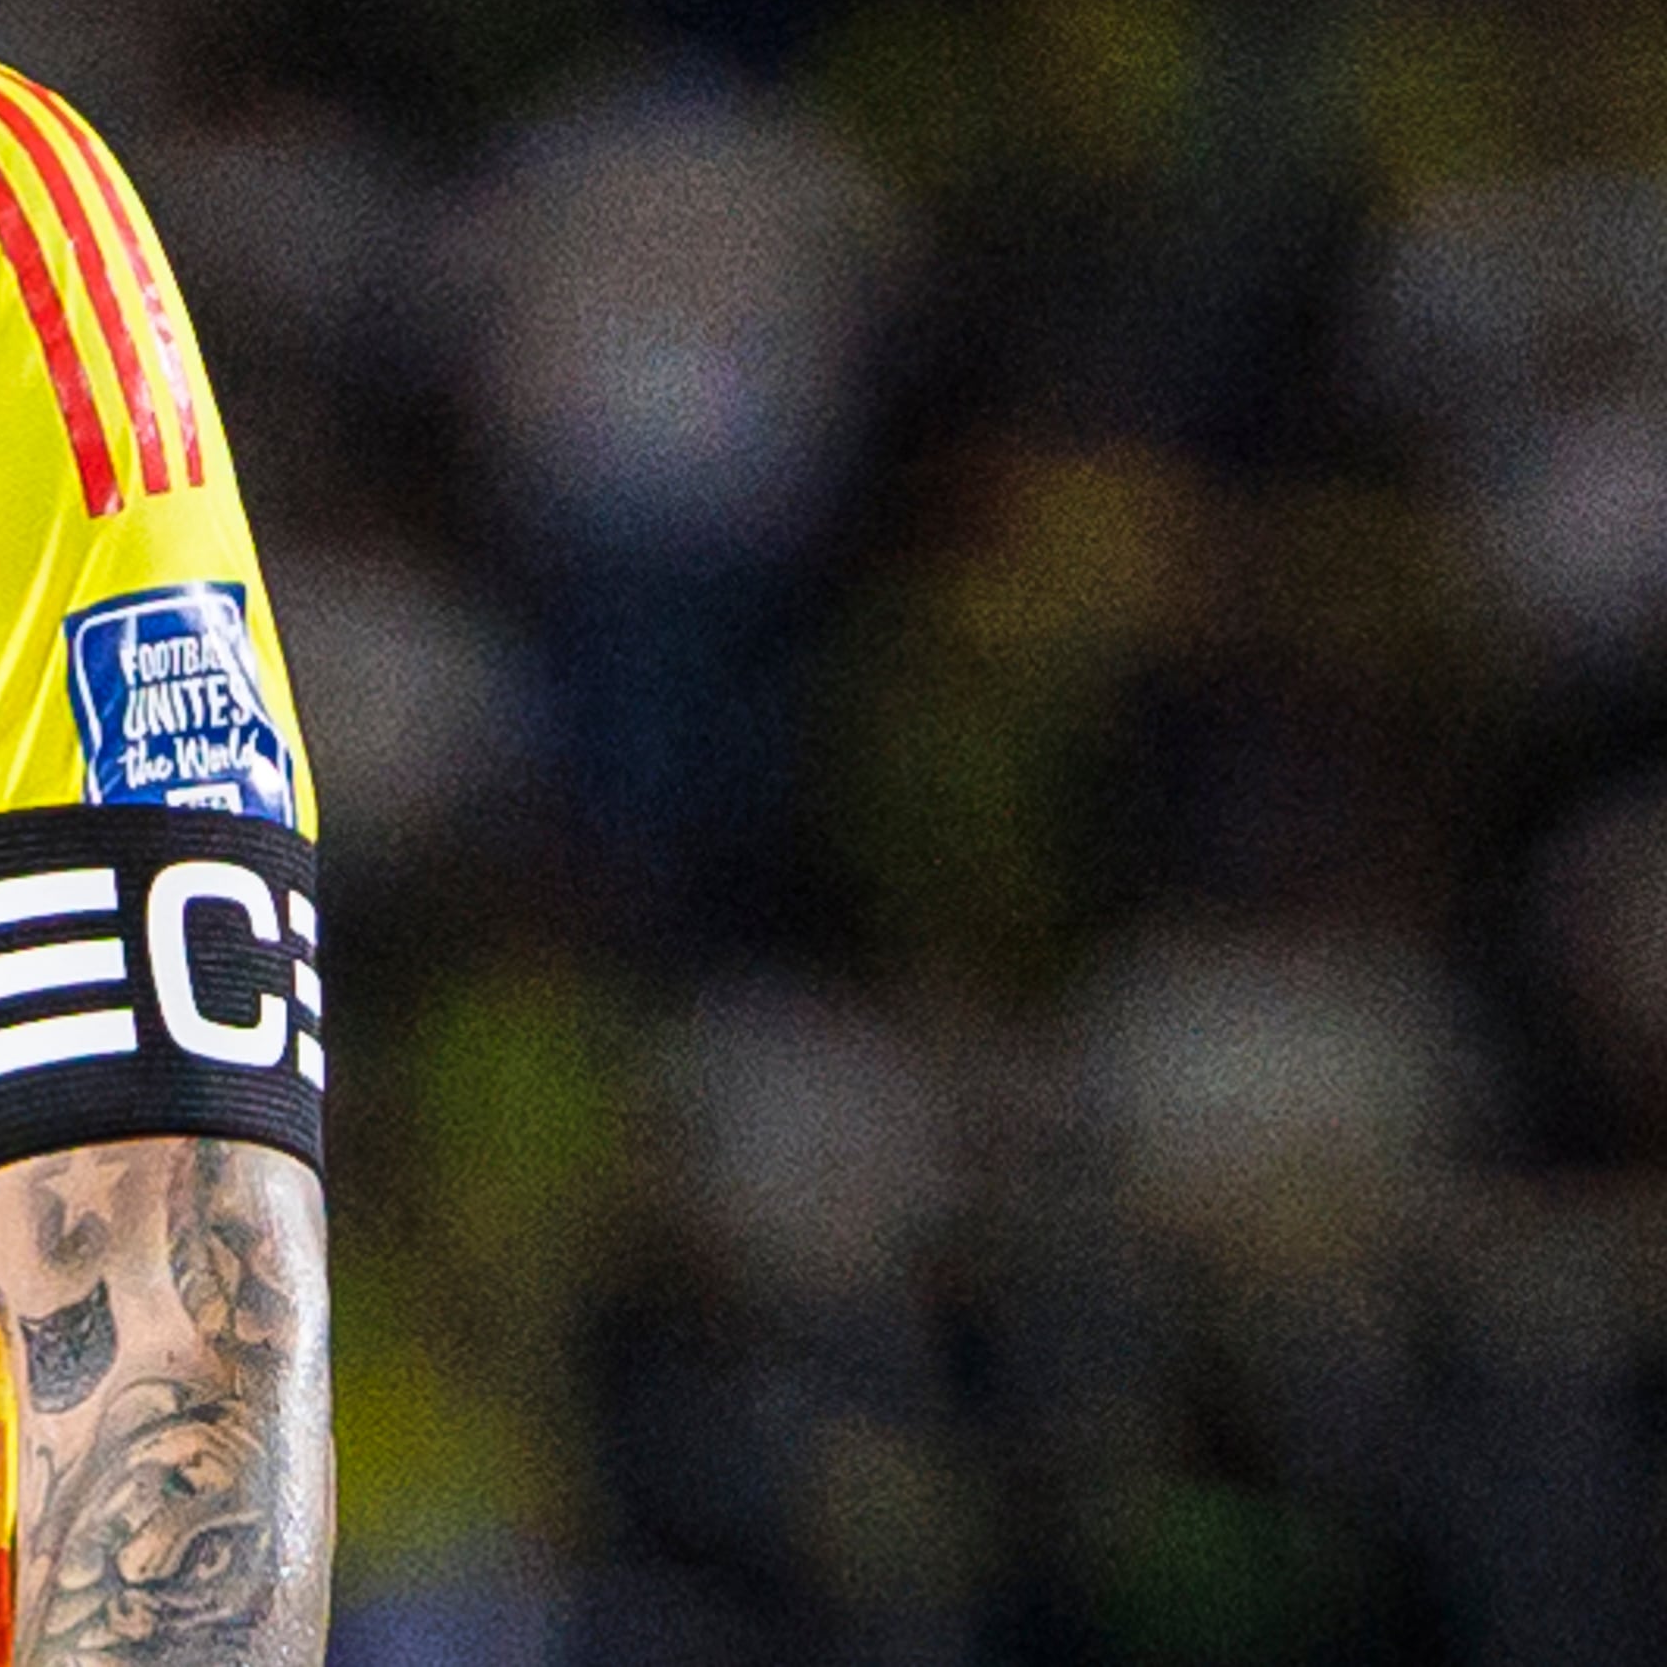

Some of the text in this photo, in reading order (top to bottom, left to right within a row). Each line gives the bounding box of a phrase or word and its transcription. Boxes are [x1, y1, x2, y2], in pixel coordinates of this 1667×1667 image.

[120, 633, 234, 685] FOOTBA
[116, 728, 259, 790] the World
[147, 861, 287, 1067] C
